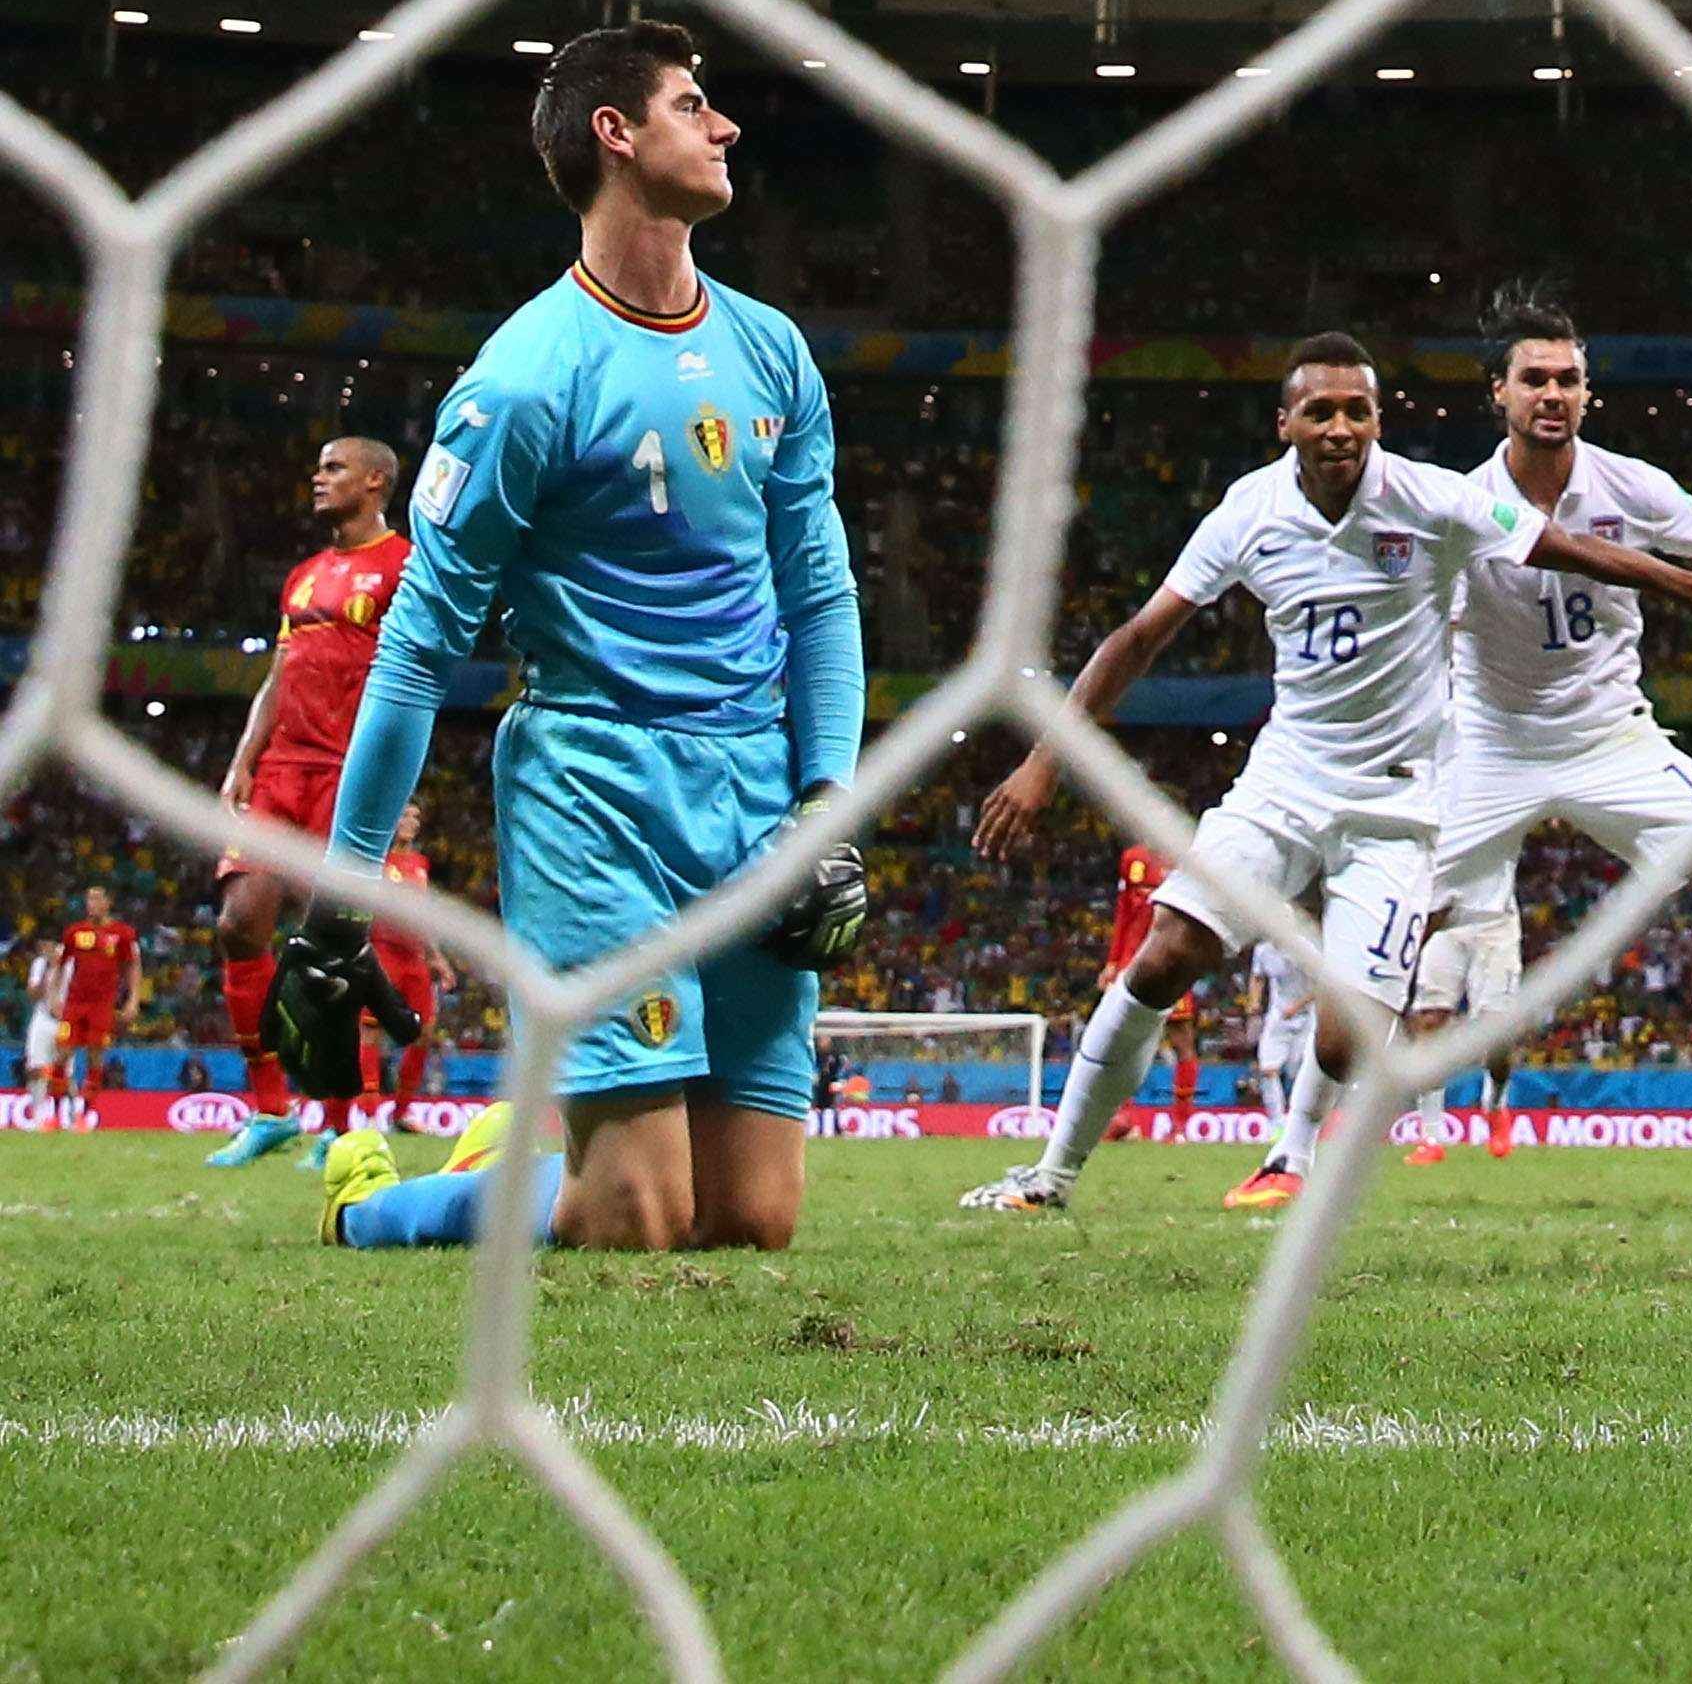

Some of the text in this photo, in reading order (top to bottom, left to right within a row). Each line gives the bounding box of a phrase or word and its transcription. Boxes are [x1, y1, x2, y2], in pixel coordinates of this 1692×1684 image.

[631, 428, 668, 515] 1
[1297, 599, 1364, 664] 16
[1537, 591, 1596, 651] 18
